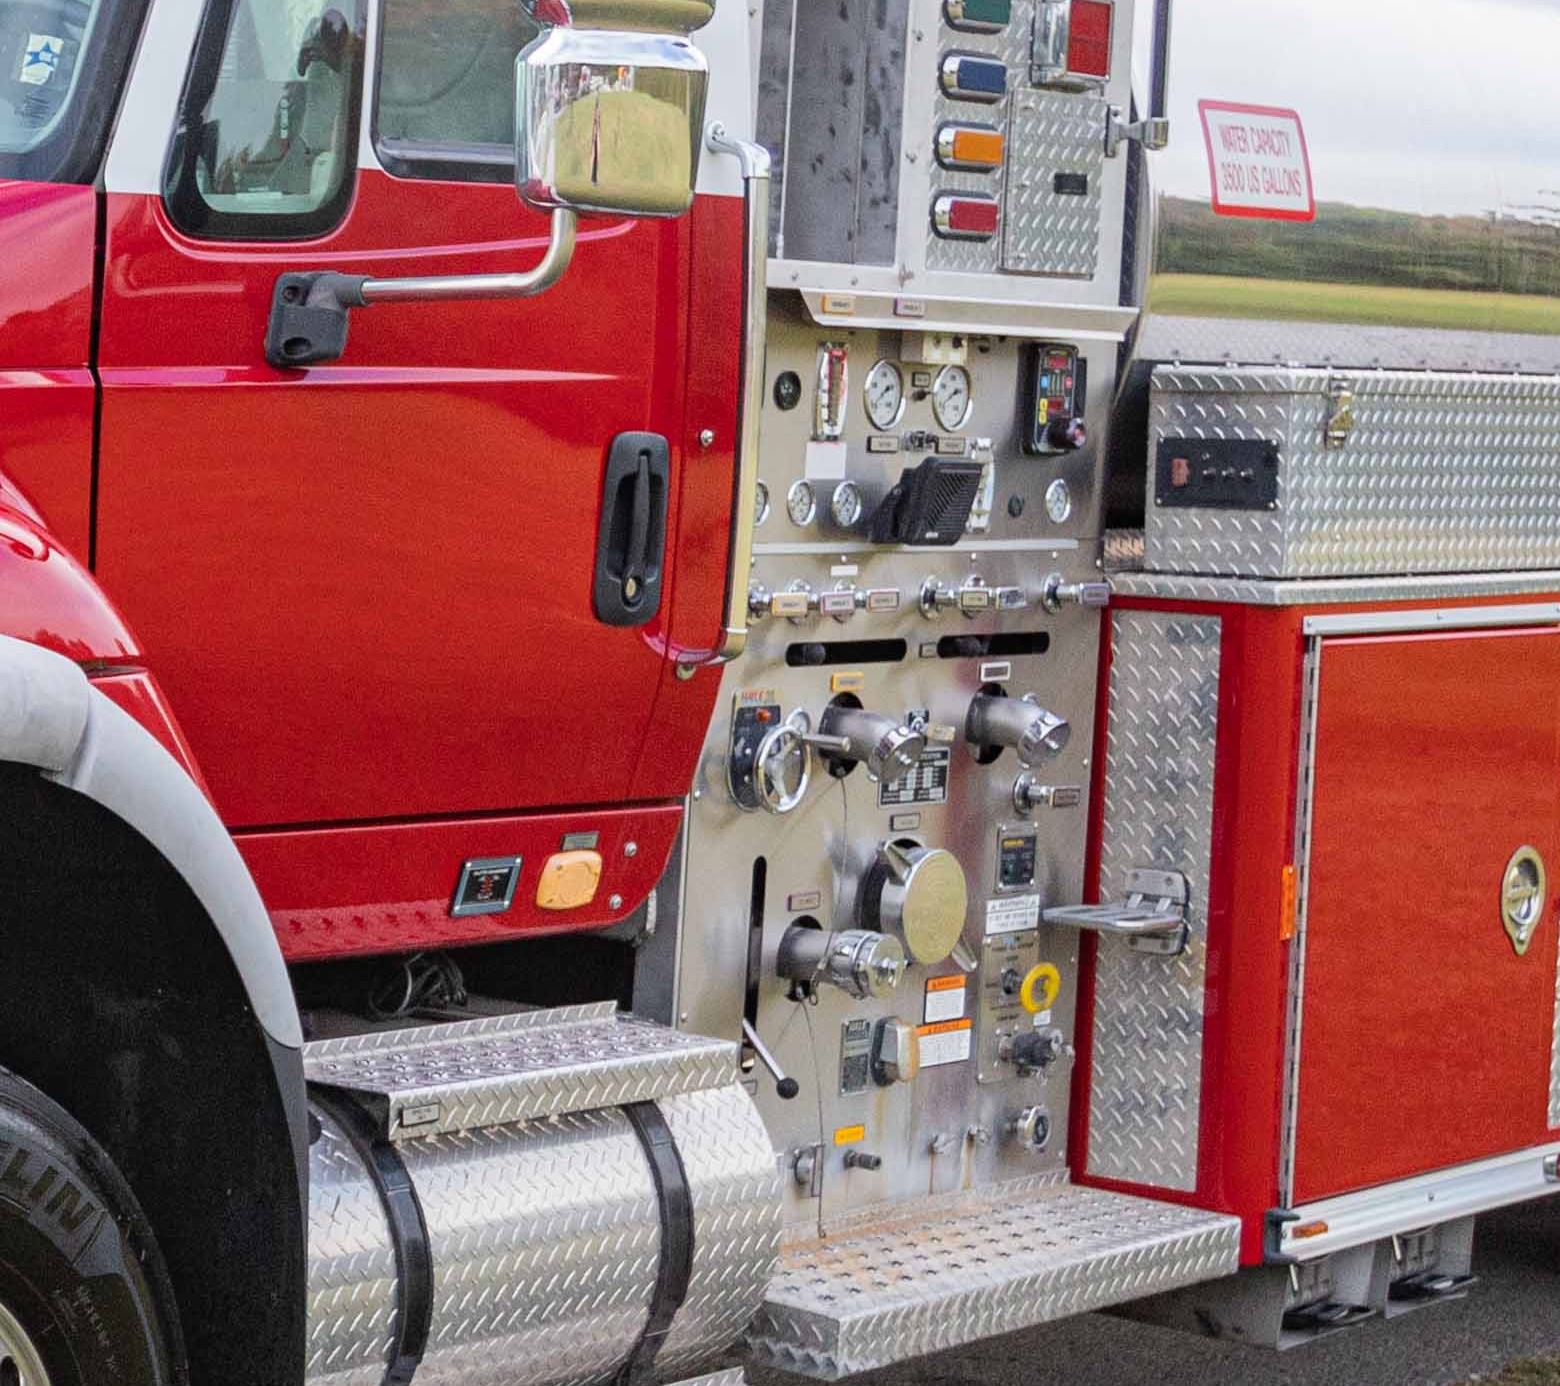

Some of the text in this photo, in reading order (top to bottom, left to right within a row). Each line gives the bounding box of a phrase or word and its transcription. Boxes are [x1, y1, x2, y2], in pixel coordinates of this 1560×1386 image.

[1218, 124, 1291, 157] WATER CAPACITY
[1221, 163, 1302, 197] 3500 US GALLONS
